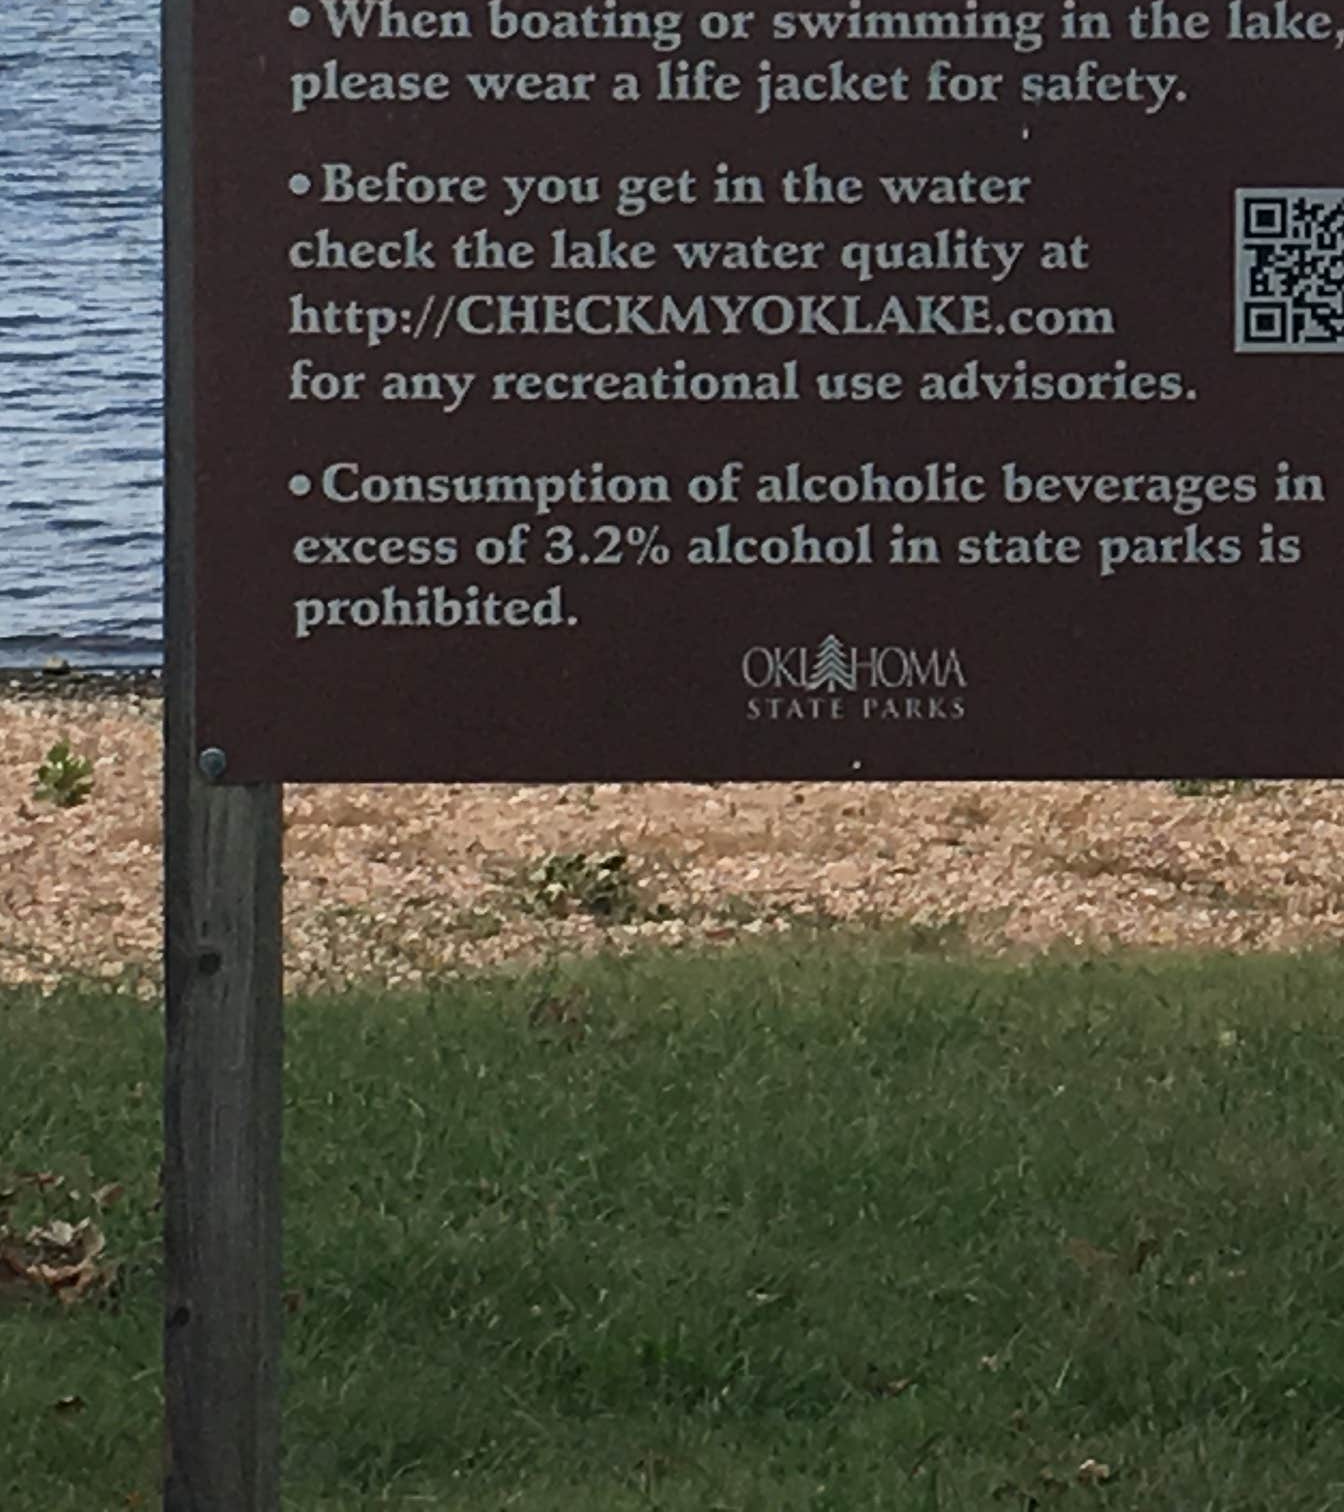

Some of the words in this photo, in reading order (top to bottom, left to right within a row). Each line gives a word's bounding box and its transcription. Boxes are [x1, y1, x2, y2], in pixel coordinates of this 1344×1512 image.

[700, 11, 755, 39] or
[1129, 0, 1209, 39] the
[290, 59, 449, 113] please
[466, 73, 596, 101] wear
[612, 73, 640, 101] a
[657, 59, 741, 101] life
[756, 59, 909, 114] jacket
[927, 60, 1003, 102] for
[1022, 60, 1187, 114] safety.
[320, 161, 487, 203] Before
[502, 175, 600, 216] you
[616, 169, 697, 217] get
[714, 162, 765, 203] in
[782, 162, 863, 204] the
[879, 170, 1031, 204] water
[288, 228, 436, 269] check
[452, 228, 535, 269] the
[551, 228, 656, 269] lake
[673, 235, 825, 269] water
[841, 228, 1024, 282] quality
[1041, 235, 1089, 269] at
[289, 293, 1115, 347] http://CHECKMYOKLAKE.com
[289, 358, 366, 400] for
[382, 372, 476, 413] any
[492, 359, 799, 400] recreational
[816, 373, 902, 400] use
[919, 359, 1196, 400] advisories.
[322, 462, 671, 515] Consumption
[688, 462, 743, 503] of
[756, 462, 985, 503] alcoholic
[1001, 462, 1257, 515] beverages
[1275, 461, 1325, 501] in
[293, 536, 457, 565] excess
[475, 523, 531, 565] of
[544, 525, 670, 565] 3.2%
[687, 523, 873, 564] alcohol
[889, 523, 940, 563] in
[958, 530, 1081, 564] state
[1099, 523, 1241, 576] parks
[1259, 522, 1300, 563] is
[293, 585, 578, 638] prohibited.
[746, 697, 845, 720] STATE
[862, 697, 966, 720] PARKS
